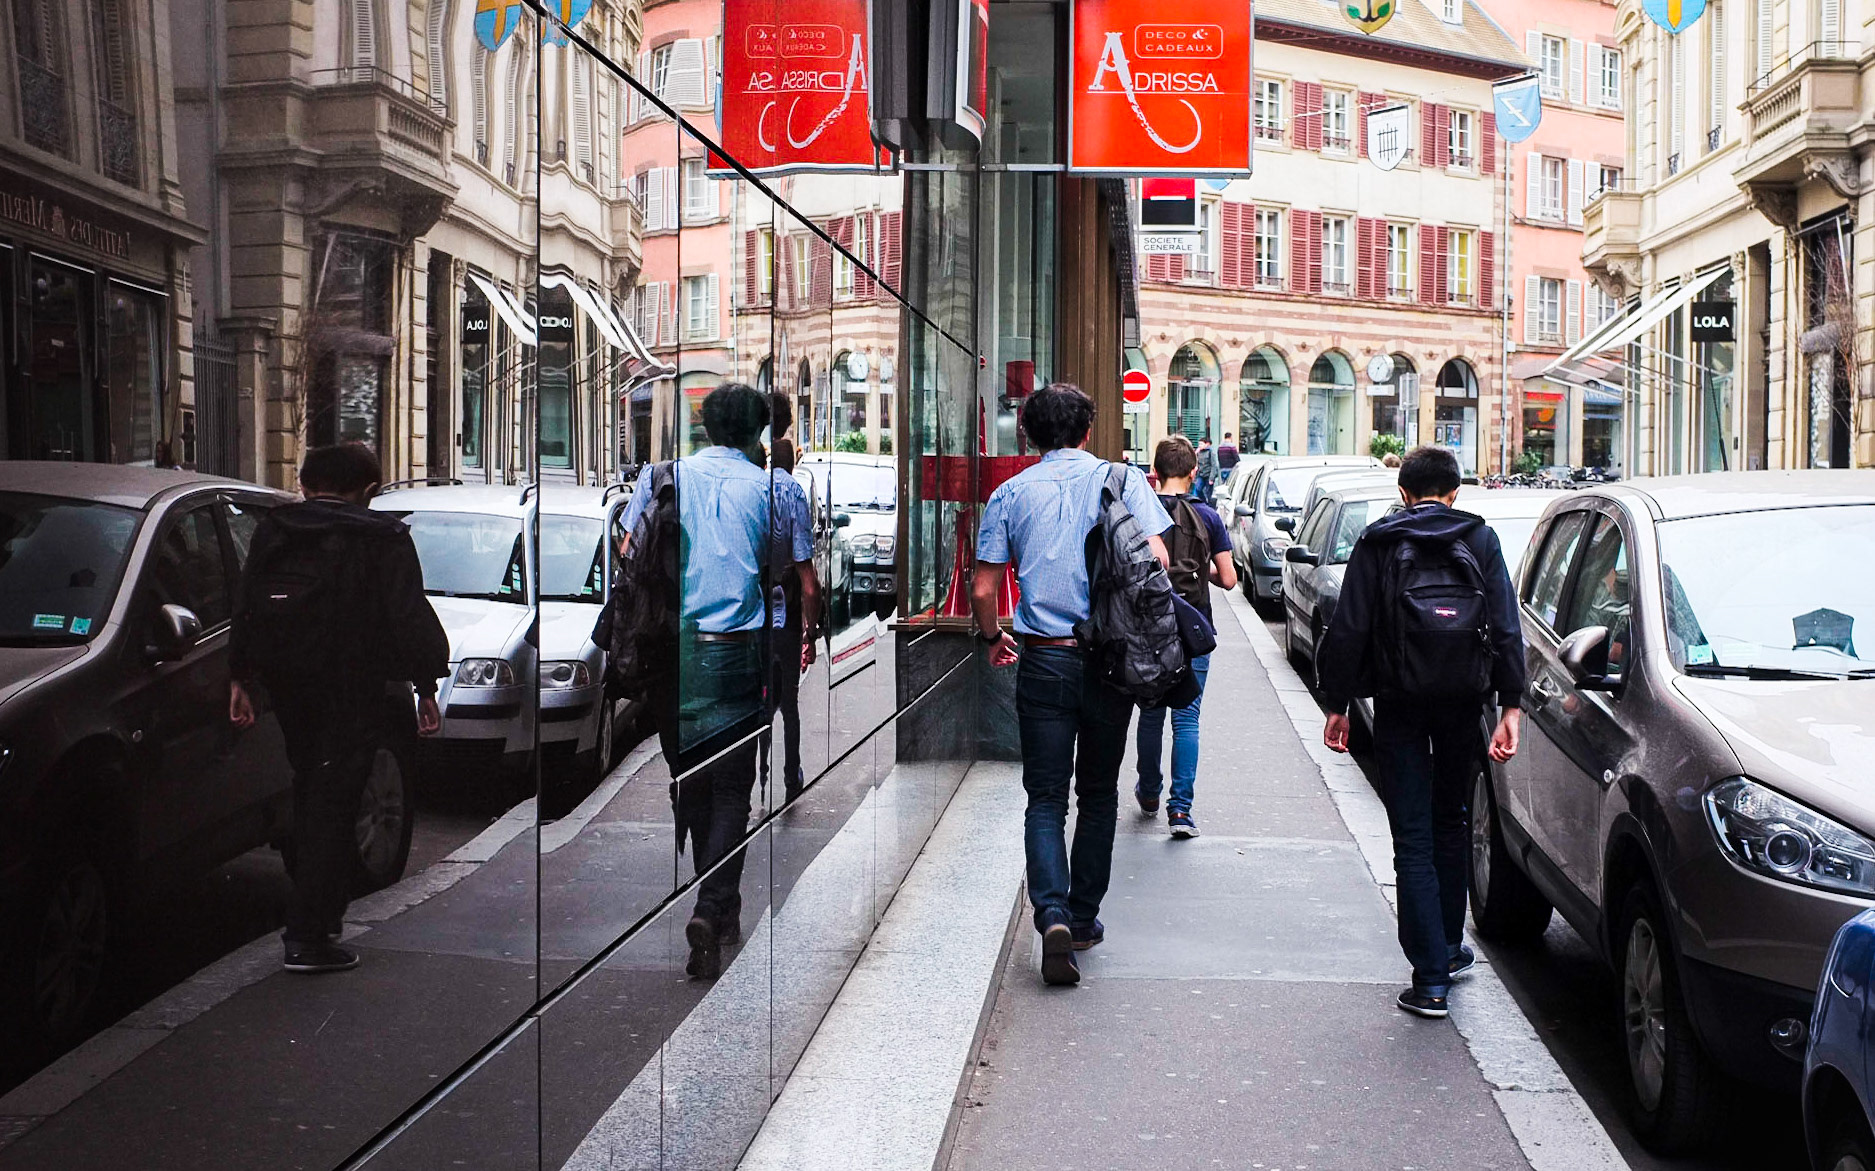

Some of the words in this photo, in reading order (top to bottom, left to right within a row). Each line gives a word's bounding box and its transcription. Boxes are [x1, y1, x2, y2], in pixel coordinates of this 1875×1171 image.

[1145, 31, 1187, 39] DECO
[1192, 28, 1209, 40] &
[1145, 44, 1213, 52] CADEAUX
[1693, 316, 1730, 328] LOLA
